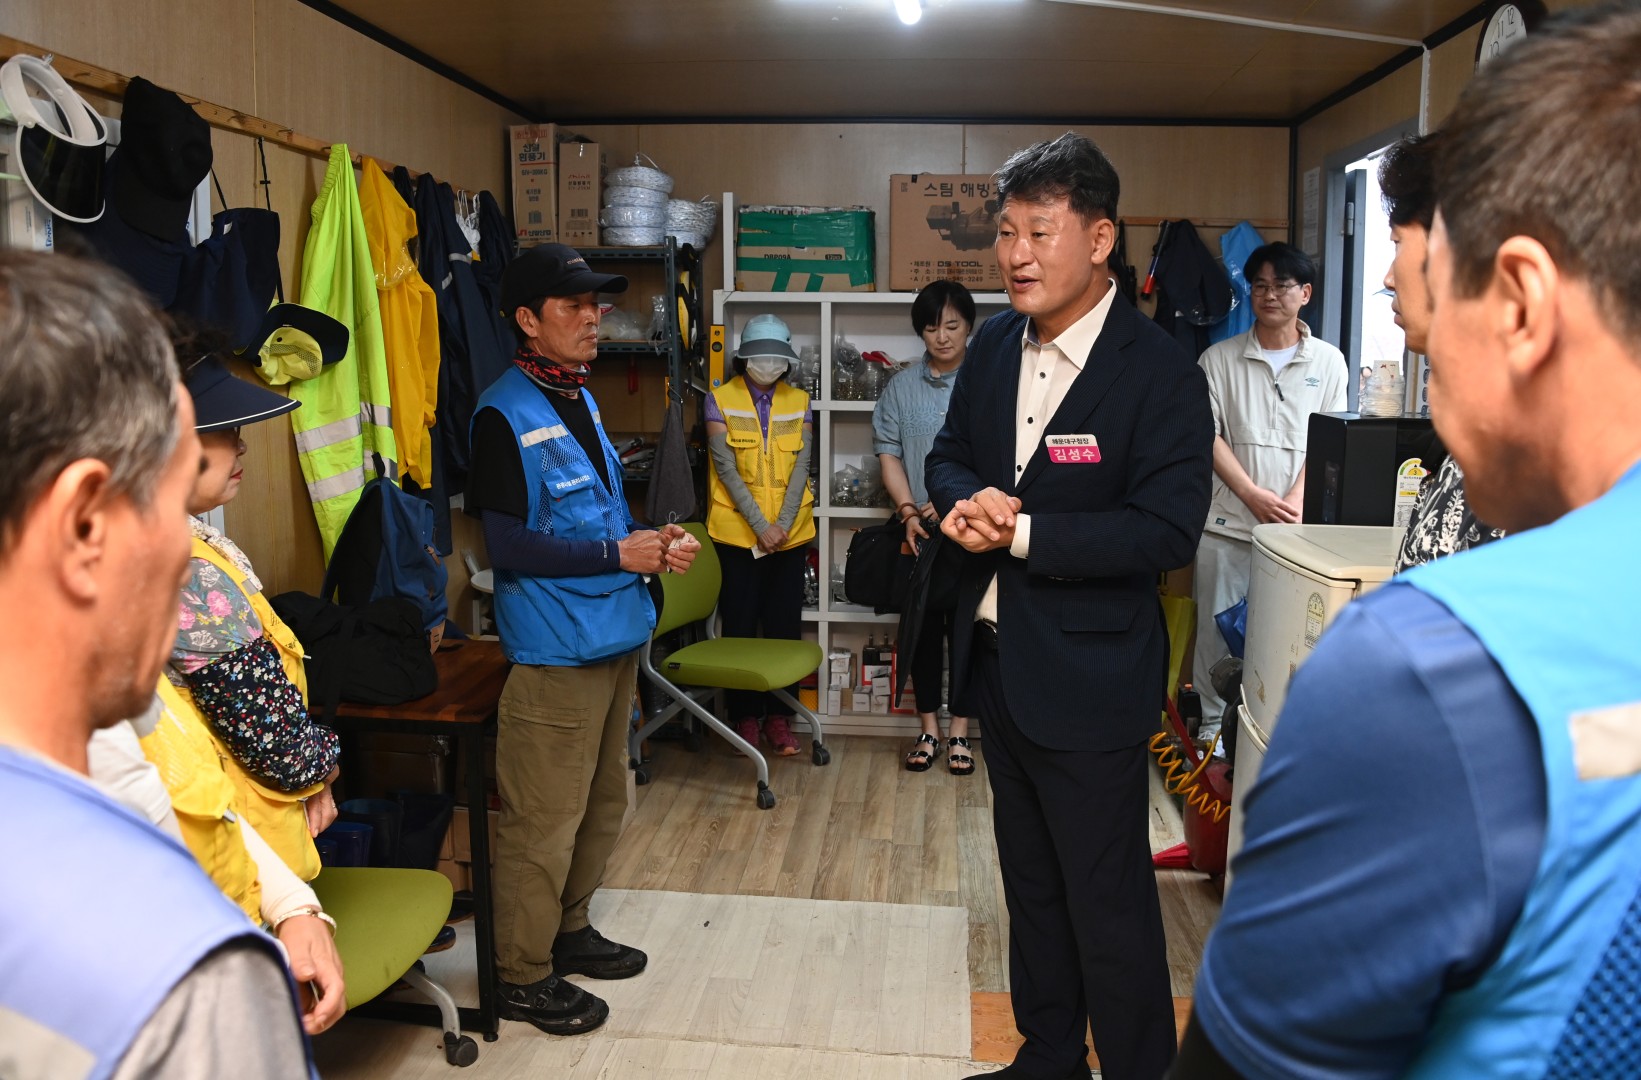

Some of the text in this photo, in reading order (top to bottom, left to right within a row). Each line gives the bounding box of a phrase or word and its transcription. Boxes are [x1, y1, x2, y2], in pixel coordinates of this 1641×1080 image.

[1507, 7, 1514, 25] 12
[1497, 20, 1504, 39] 11
[924, 183, 953, 197] 스팀
[1054, 448, 1095, 461] 김성수
